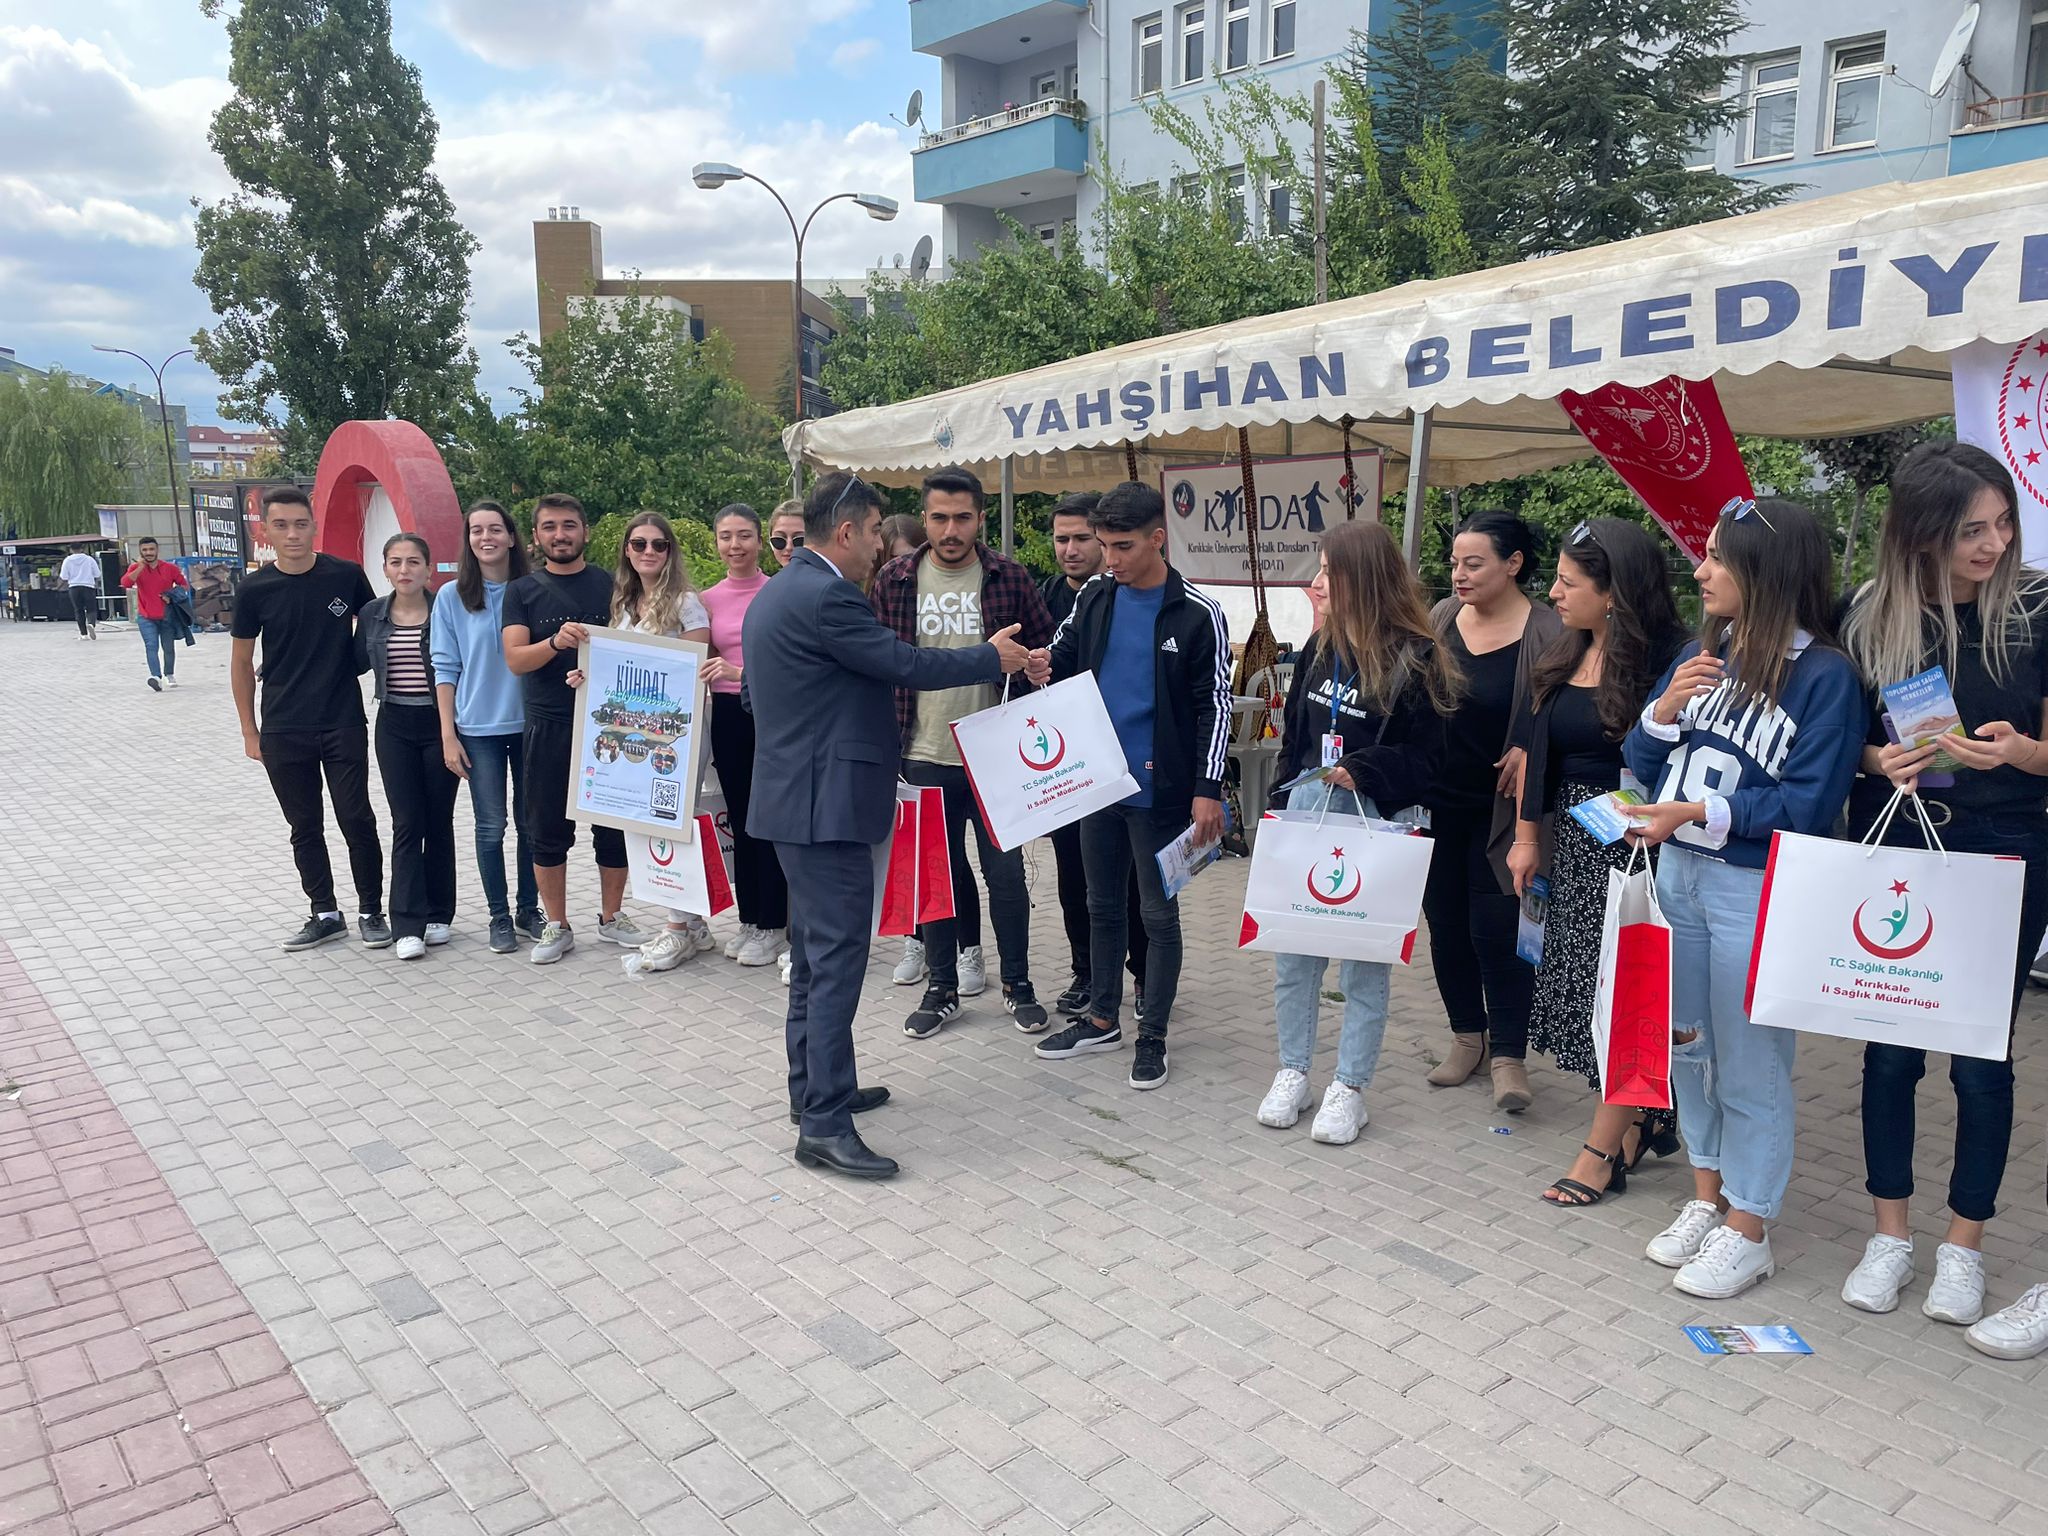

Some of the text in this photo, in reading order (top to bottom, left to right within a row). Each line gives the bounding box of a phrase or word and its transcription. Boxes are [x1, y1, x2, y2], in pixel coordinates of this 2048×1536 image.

[1003, 351, 1348, 431] YAHŞİHAN
[1258, 541, 1274, 553] Halk
[1242, 559, 1284, 571] (KHDAT)
[916, 613, 985, 636] ONE
[617, 660, 669, 702] KÜHDAT
[1886, 685, 1909, 698] TOPLUM
[1908, 680, 1921, 690] RUH
[1033, 773, 1054, 787] Sağlık
[1055, 761, 1086, 778] Bakanlığı
[1034, 794, 1056, 808] Sağlık
[1057, 778, 1093, 798] Müdürlüğü
[1042, 778, 1073, 796] Kırıkkale
[1304, 905, 1329, 914] Sağlık
[1331, 909, 1368, 919] Bakanlığı
[1829, 957, 1943, 982] T.C. Sağlık Bakanlığı
[1855, 978, 1910, 993] Kırıkkale
[1833, 987, 1871, 999] Sağlık
[1875, 992, 1940, 1009] Müdürlüğü
